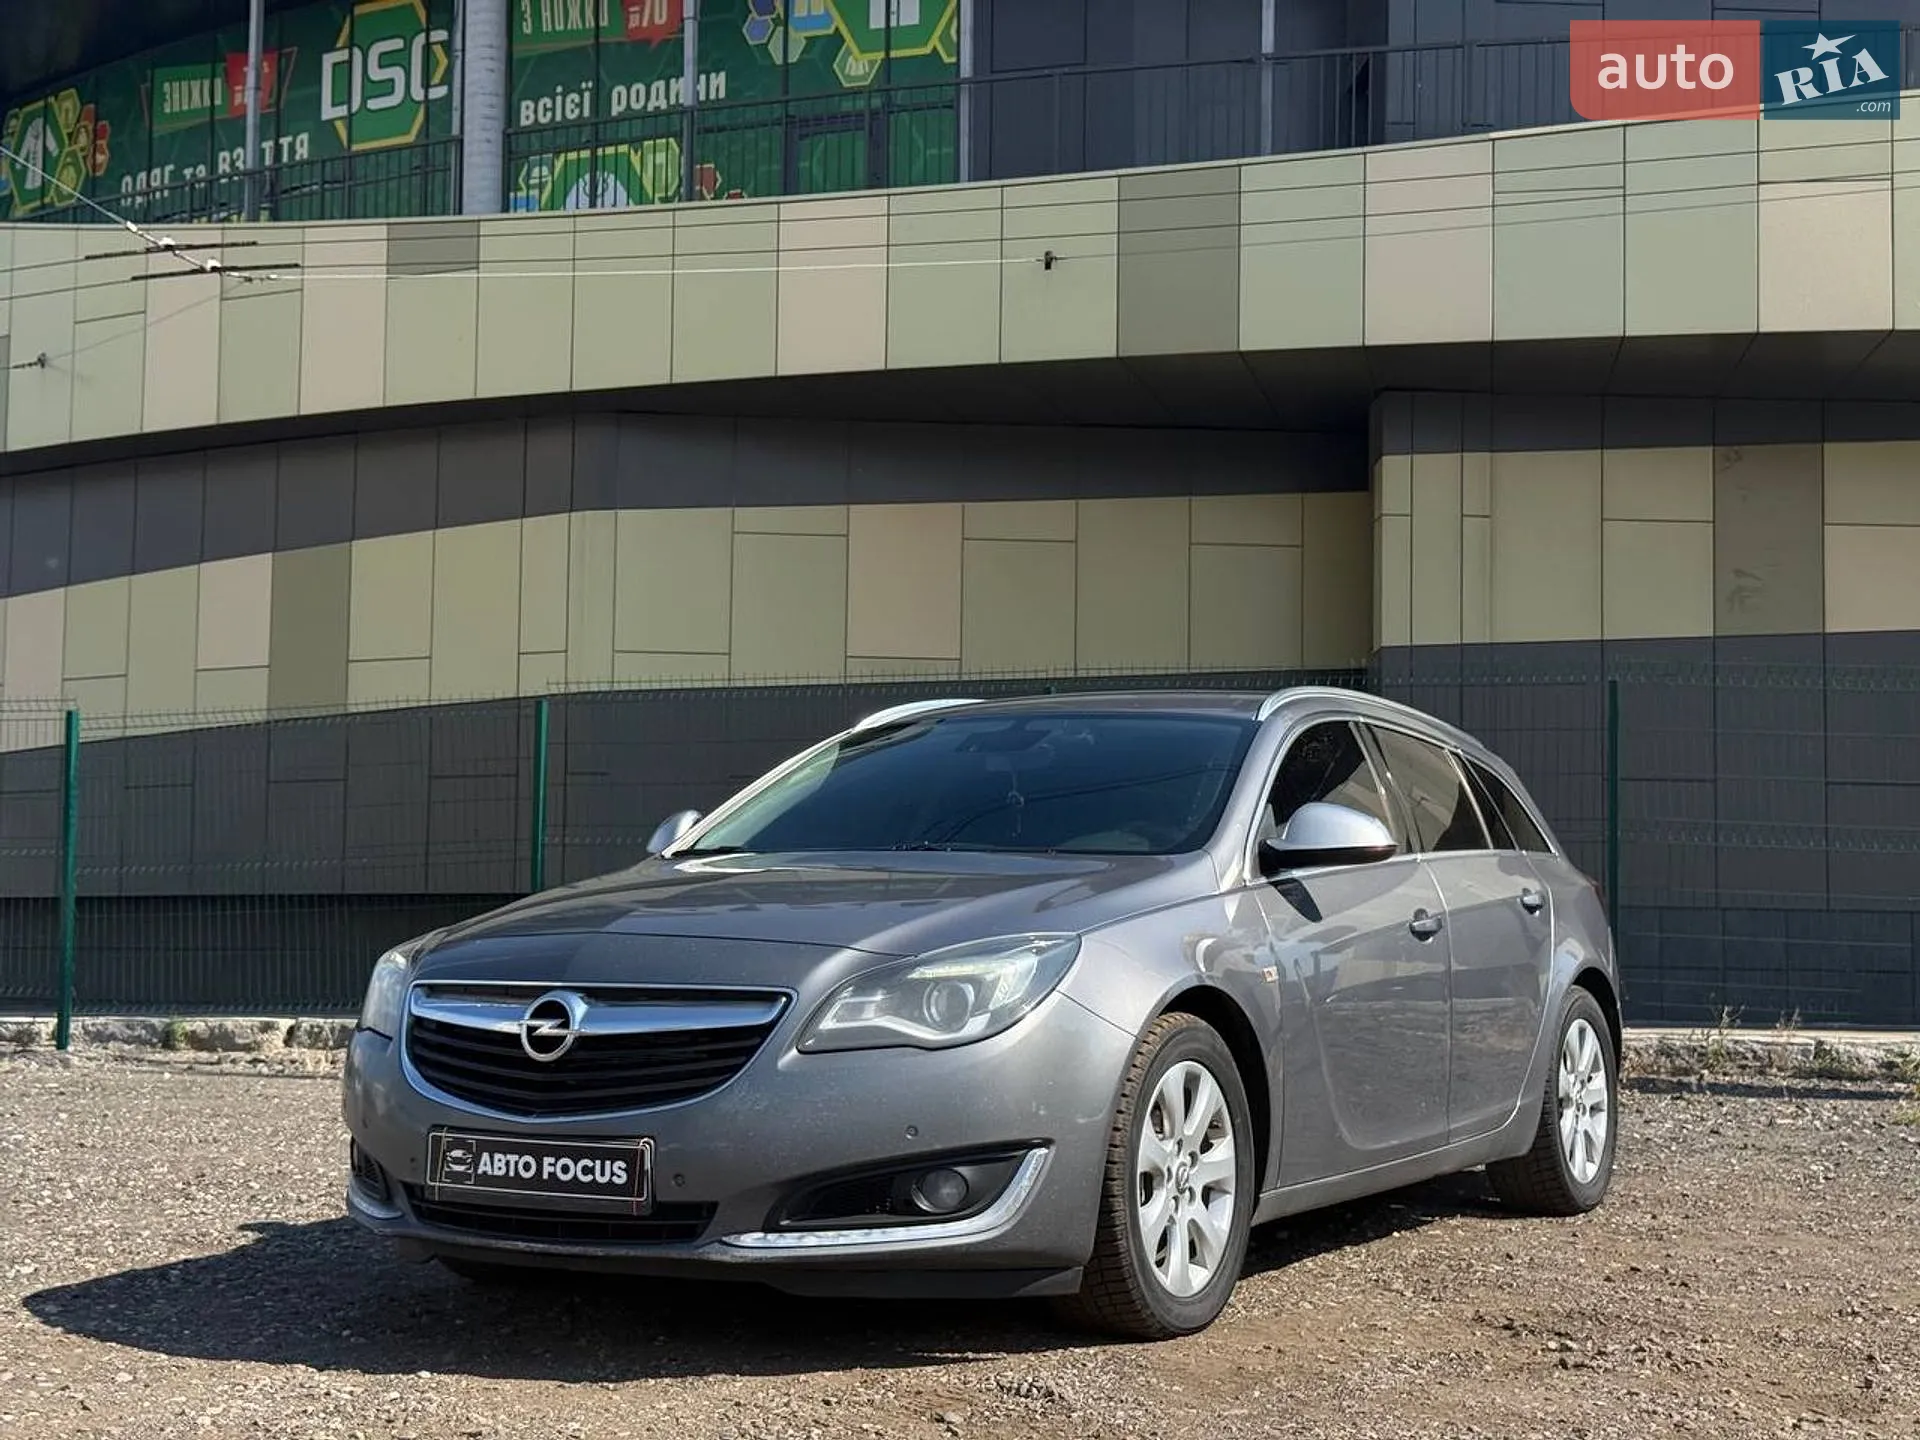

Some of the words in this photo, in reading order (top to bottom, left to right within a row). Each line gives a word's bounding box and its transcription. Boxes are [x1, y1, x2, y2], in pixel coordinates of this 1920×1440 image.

[321, 29, 449, 121] DSC
[520, 80, 593, 127] всієї
[218, 132, 309, 183] ВЗТТЯ
[477, 1152, 537, 1179] АВТО
[542, 1156, 628, 1185] FOCUS
